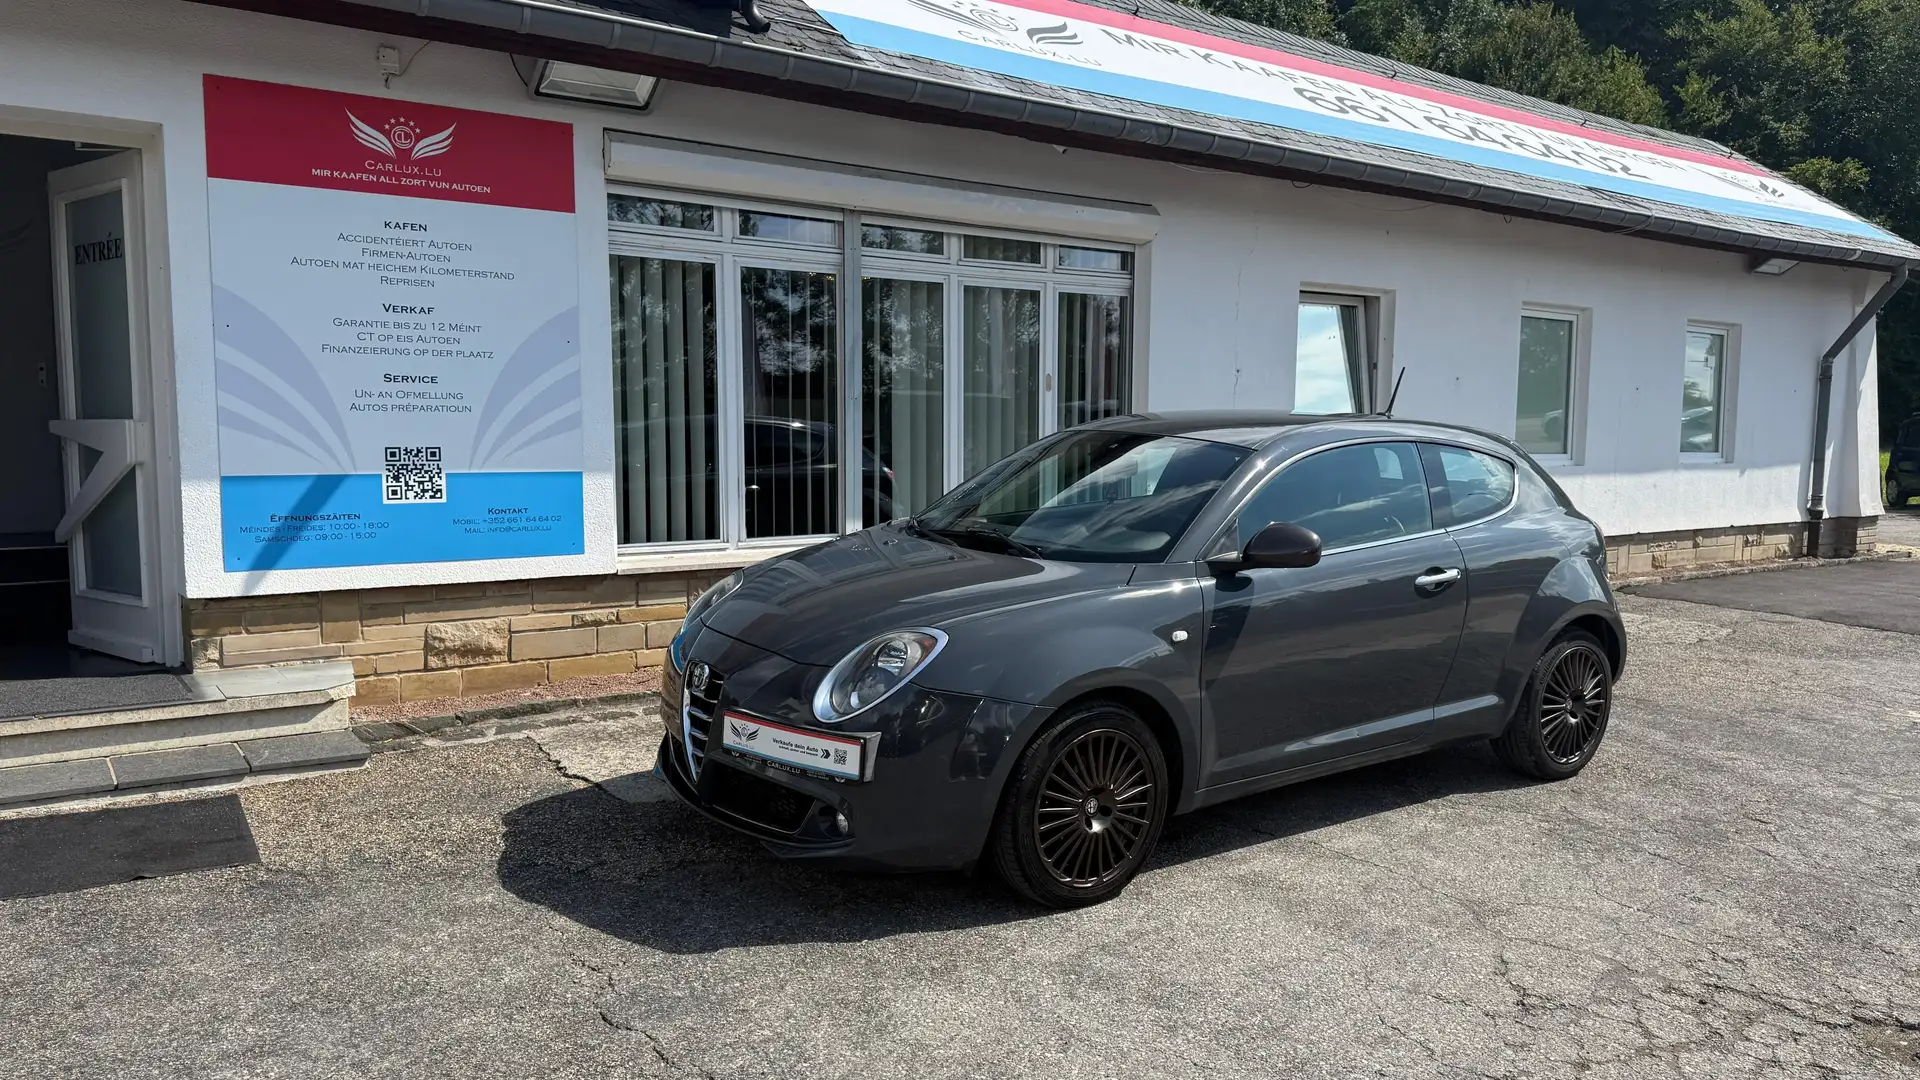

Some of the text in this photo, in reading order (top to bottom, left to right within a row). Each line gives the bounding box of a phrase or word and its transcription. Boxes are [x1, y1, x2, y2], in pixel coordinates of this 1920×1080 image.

[1100, 28, 1687, 172] MIR KAAFEN ALL ZORT VUN AUTOEN
[364, 160, 442, 177] CARLUX.LU
[312, 168, 491, 193] MIR KAAFEN ALL ZORT VUN AUTOEN
[384, 220, 428, 232] KAFEN
[75, 232, 122, 265] ENTRÉE
[337, 232, 472, 251] ACCIDENTÉIERT AUTOEN
[361, 248, 451, 263] FIRMEN-AUTOEN
[290, 257, 515, 280] AUTOEN MAT HEICHEM KILOMETERSTAND
[381, 276, 435, 287] REPRISEN
[382, 303, 435, 315] VERKAF
[333, 317, 482, 332] GARANTIE BIS ZU 12 MÉINT
[357, 332, 461, 344] CT OP EIS AUTOEN
[321, 344, 494, 359] FINANZEIERUNG OP DER PLAATZ
[384, 373, 438, 383] SERVICE
[354, 389, 375, 398] UN-
[396, 390, 464, 400] OFMELLUNG
[350, 402, 471, 412] AUTOS PRÉPARATIOUN
[255, 535, 312, 543] SAMSCHDEG:
